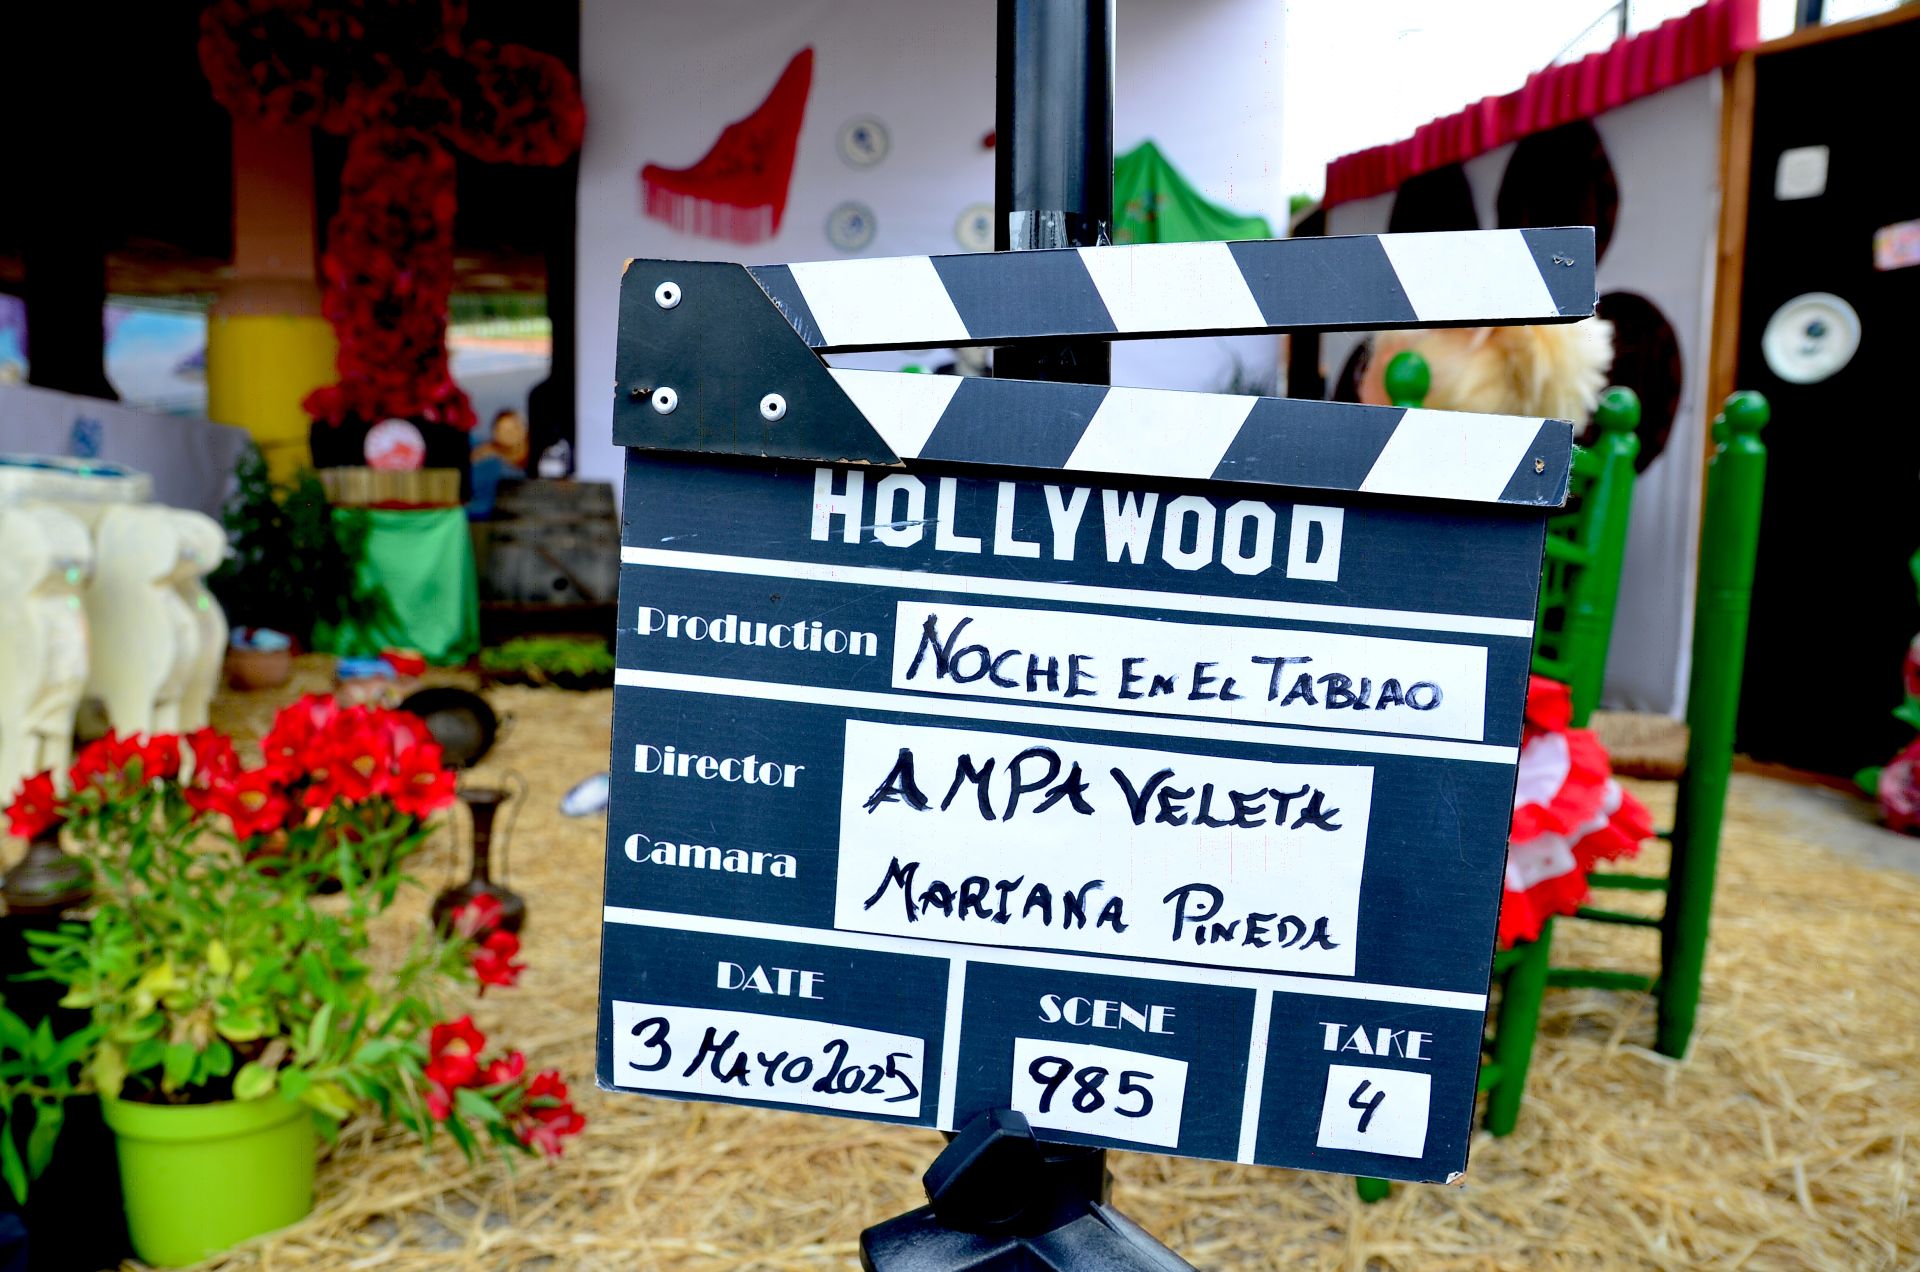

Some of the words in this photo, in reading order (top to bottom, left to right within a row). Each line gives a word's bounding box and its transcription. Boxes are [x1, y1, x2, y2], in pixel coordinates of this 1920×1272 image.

[811, 467, 1345, 582] HOLLYWOOD
[636, 605, 879, 657] Production
[905, 612, 1099, 698] NOCHE
[1251, 655, 1444, 711] TABLAO
[634, 743, 805, 789] Director
[1107, 767, 1343, 832] VELETA
[624, 832, 798, 879] Camara
[863, 856, 1129, 933] MARIANA
[715, 961, 825, 1001] DATE
[1037, 993, 1176, 1036] SCENE
[1318, 1021, 1433, 1061] TAKE
[629, 1016, 673, 1072] 3
[813, 1039, 920, 1103] 2025
[1027, 1055, 1154, 1119] 985
[1347, 1079, 1387, 1134] 4
